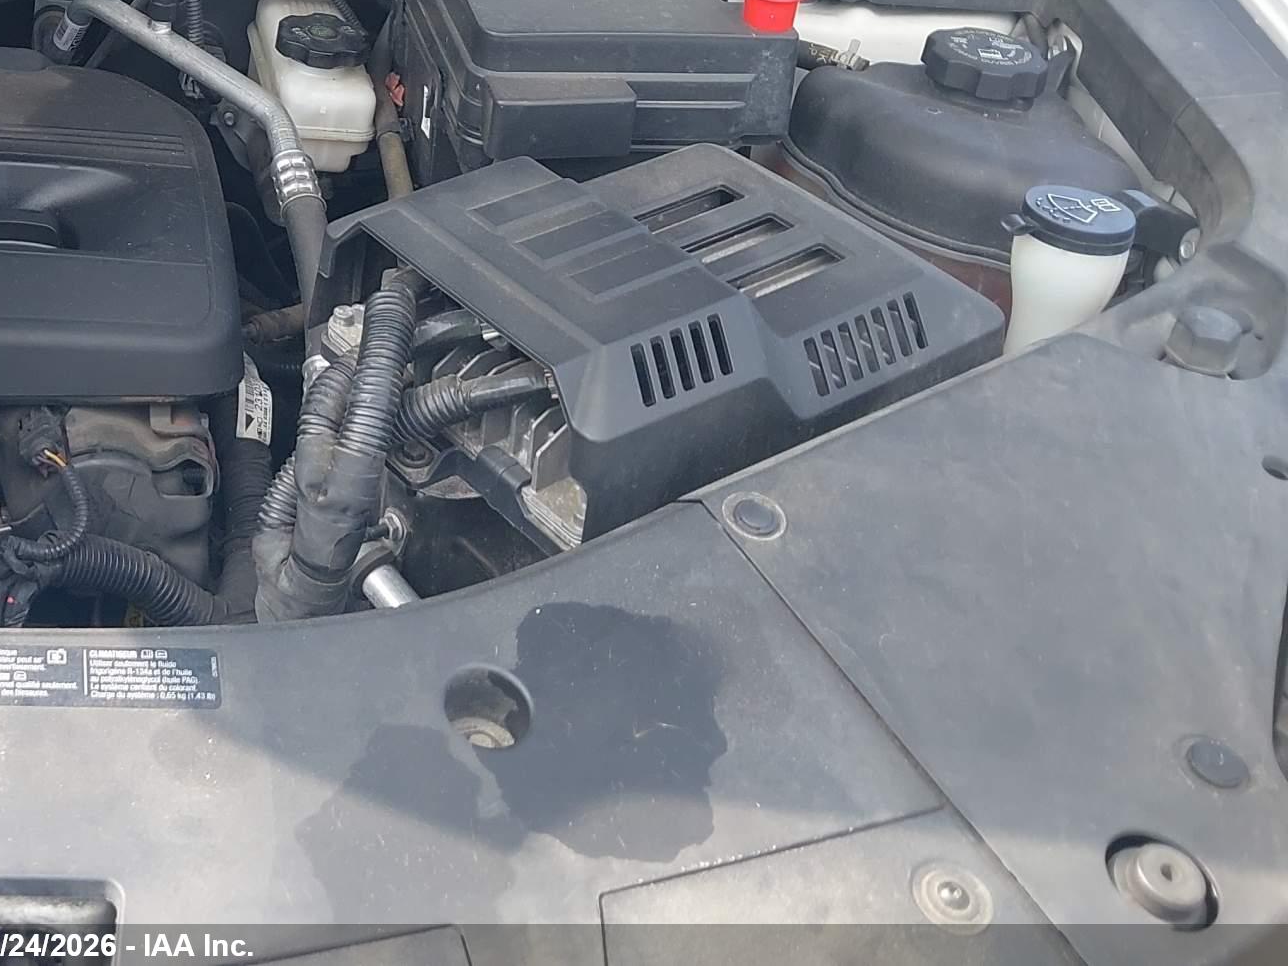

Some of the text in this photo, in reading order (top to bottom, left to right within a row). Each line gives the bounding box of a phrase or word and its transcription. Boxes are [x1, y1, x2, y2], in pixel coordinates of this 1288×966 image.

[17, 657, 32, 665] peut
[91, 691, 115, 700] Charge
[177, 692, 186, 701] kg
